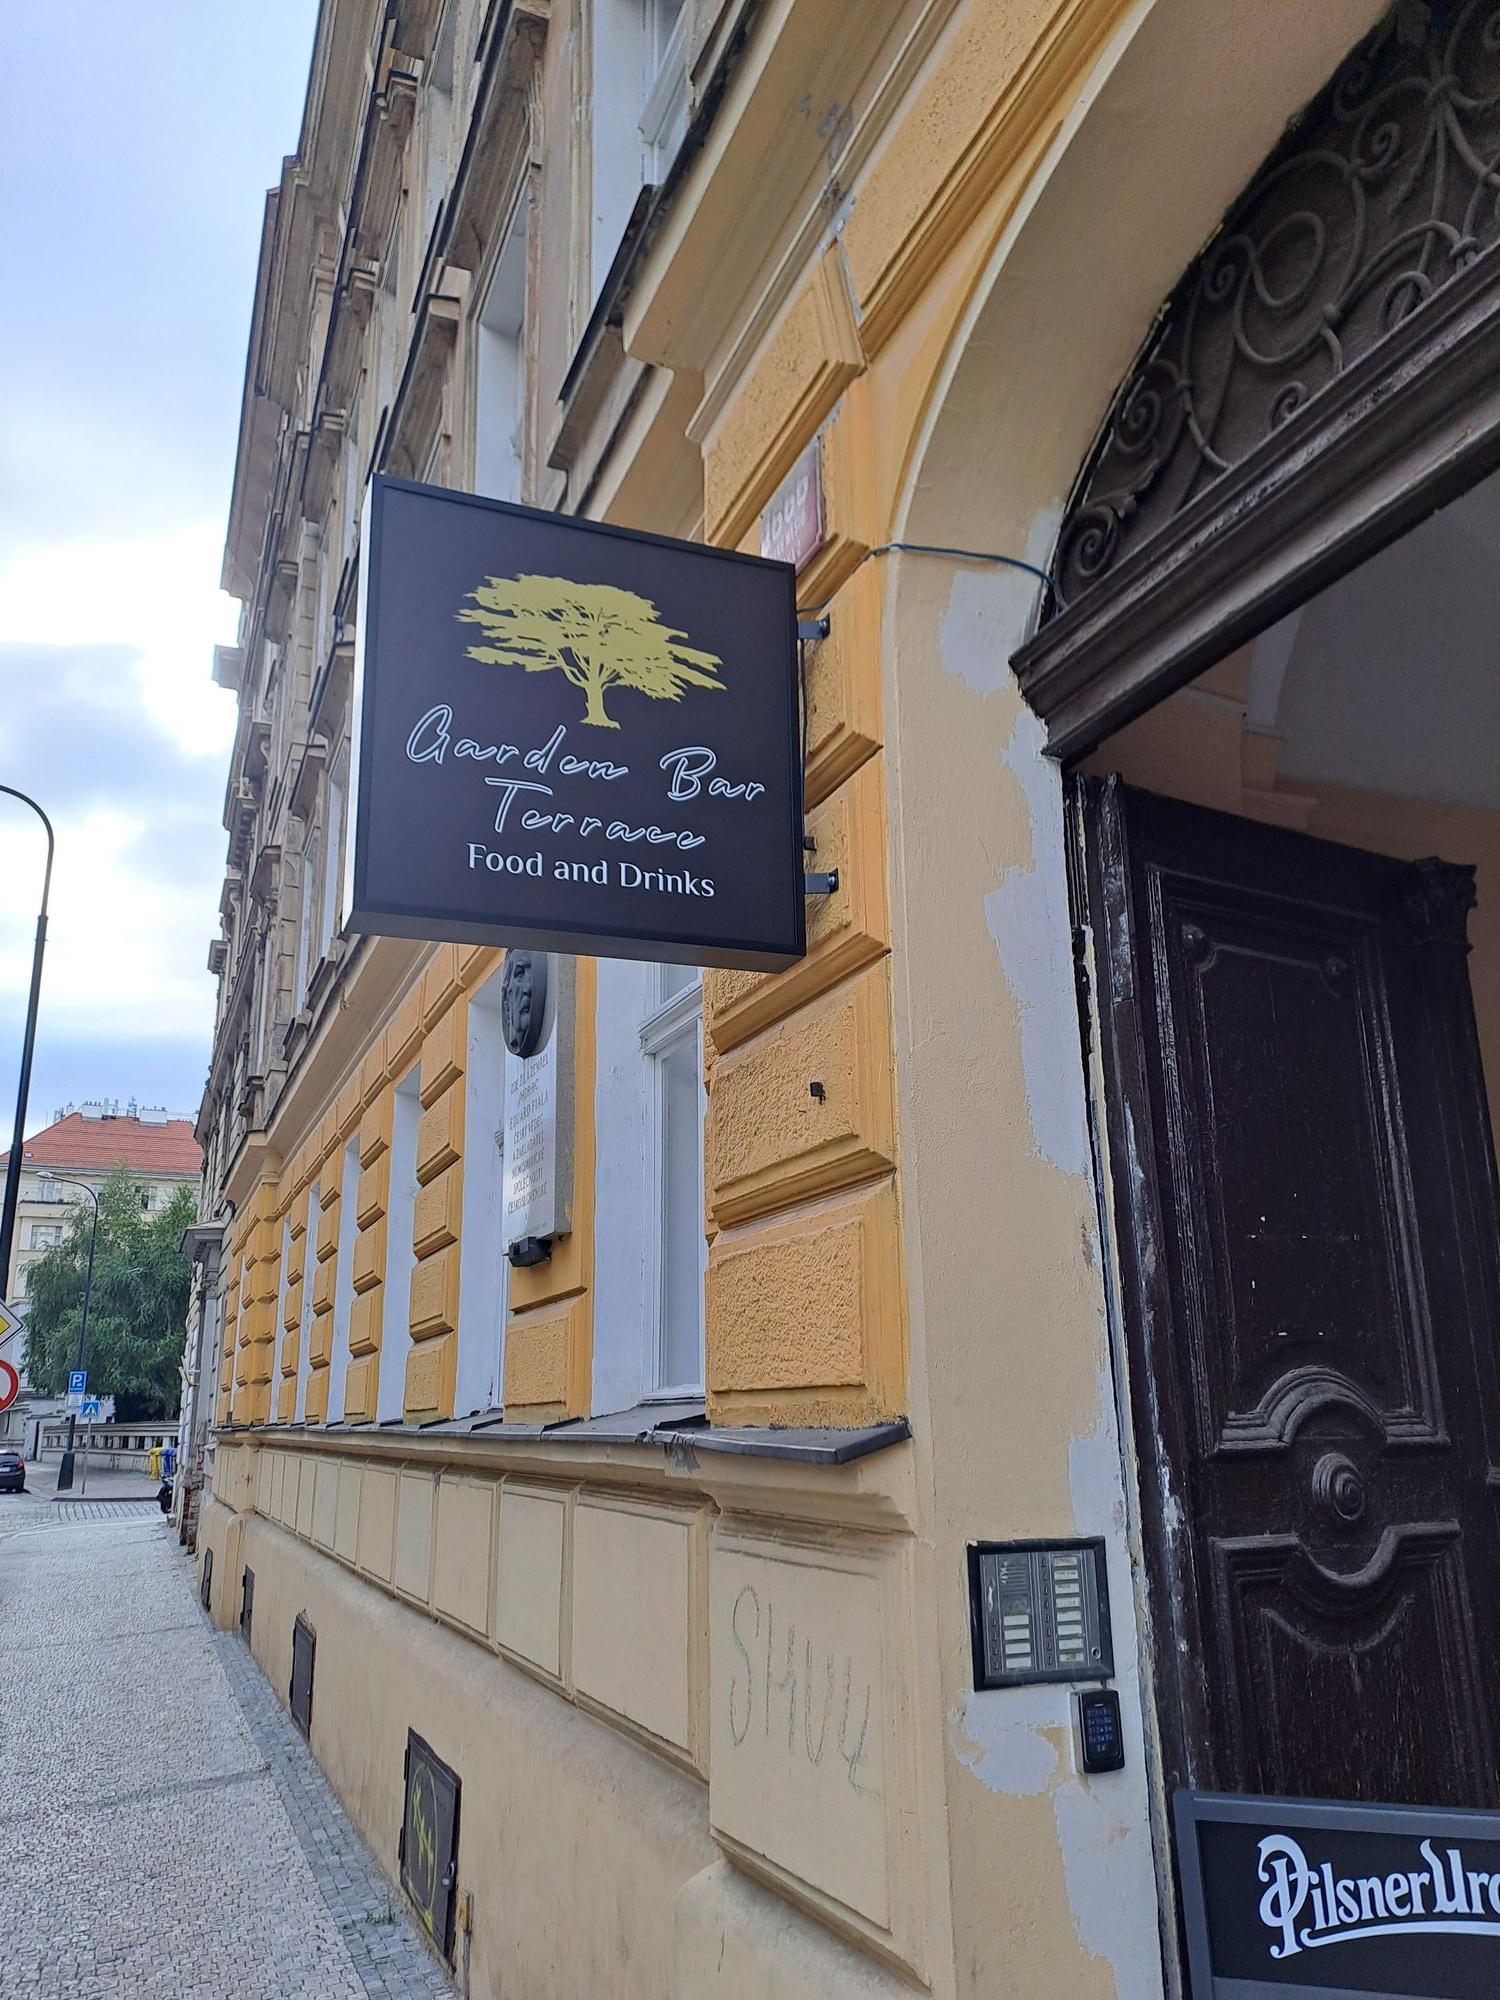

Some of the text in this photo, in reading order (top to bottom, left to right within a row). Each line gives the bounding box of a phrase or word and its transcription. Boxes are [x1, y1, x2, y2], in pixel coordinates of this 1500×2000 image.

[405, 704, 765, 801] Garden Bar
[485, 777, 707, 850] Terrace
[467, 843, 715, 897] Food and Drinks
[1256, 1834, 1431, 1960] Pilsner
